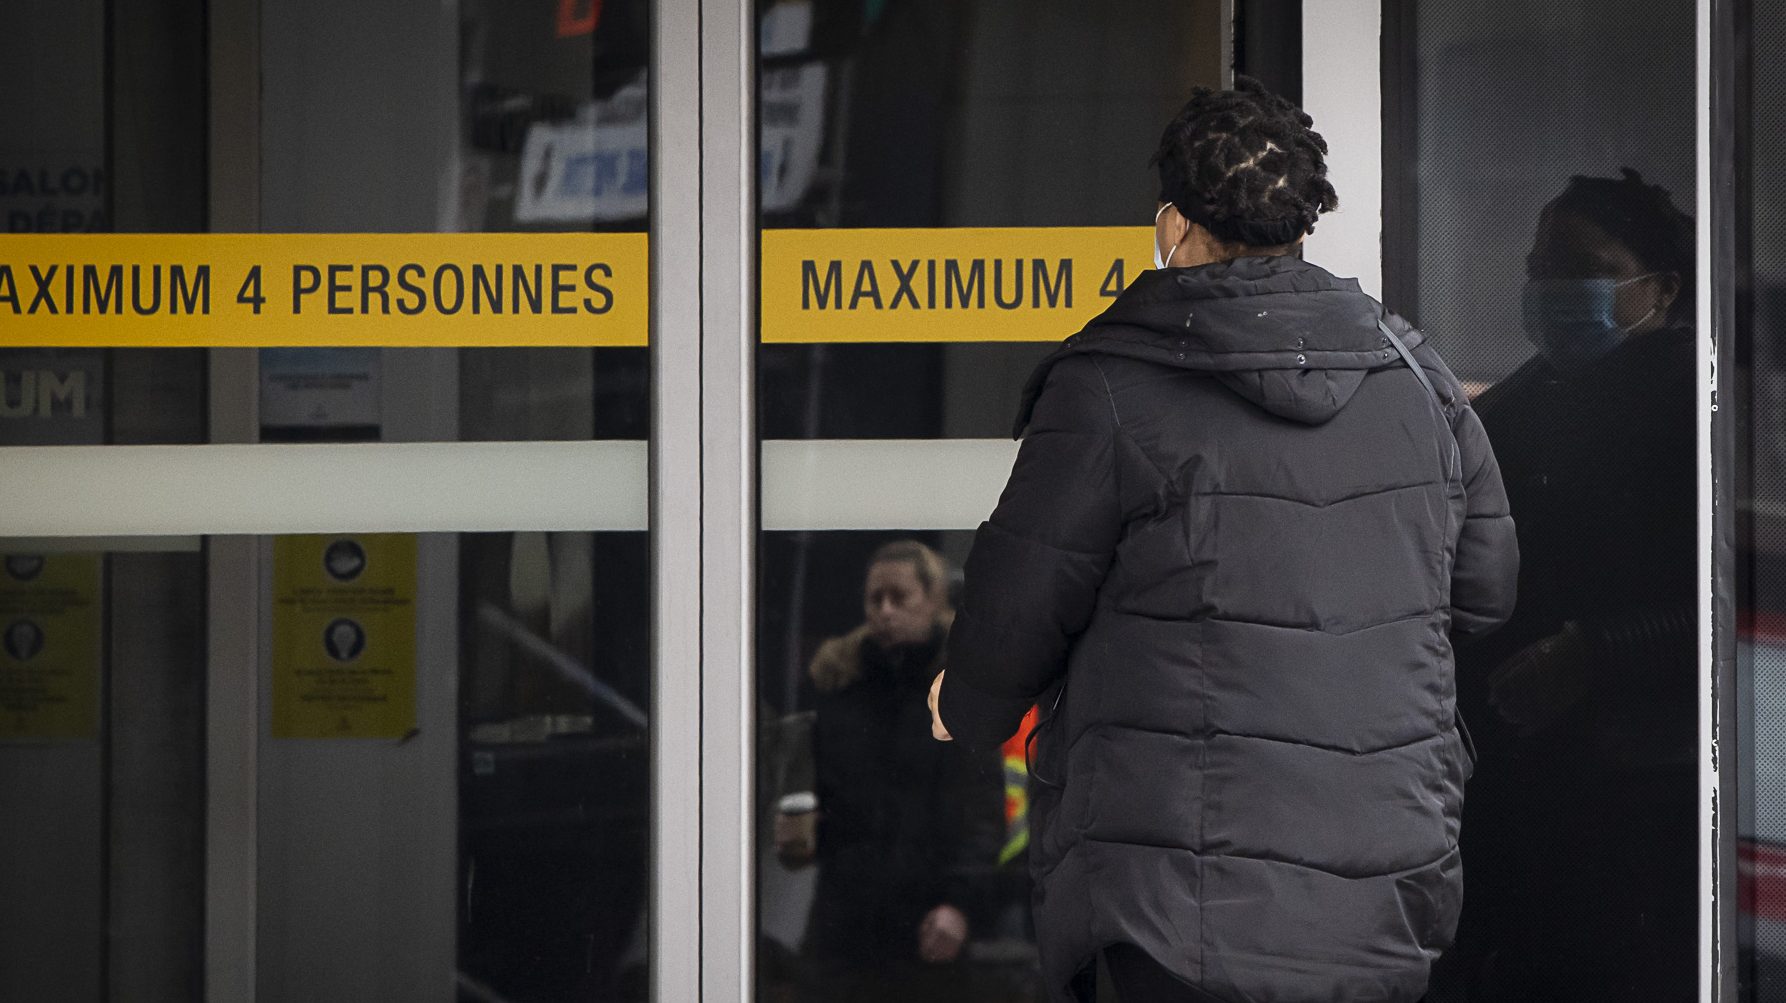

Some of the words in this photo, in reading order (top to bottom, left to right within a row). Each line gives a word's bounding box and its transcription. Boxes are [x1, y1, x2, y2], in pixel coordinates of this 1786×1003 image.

[0, 264, 210, 315] AXIMUM
[236, 264, 266, 315] 4
[292, 263, 614, 315] PERSONNES
[801, 258, 1073, 310] MAXIMUM
[1099, 258, 1124, 298] 4
